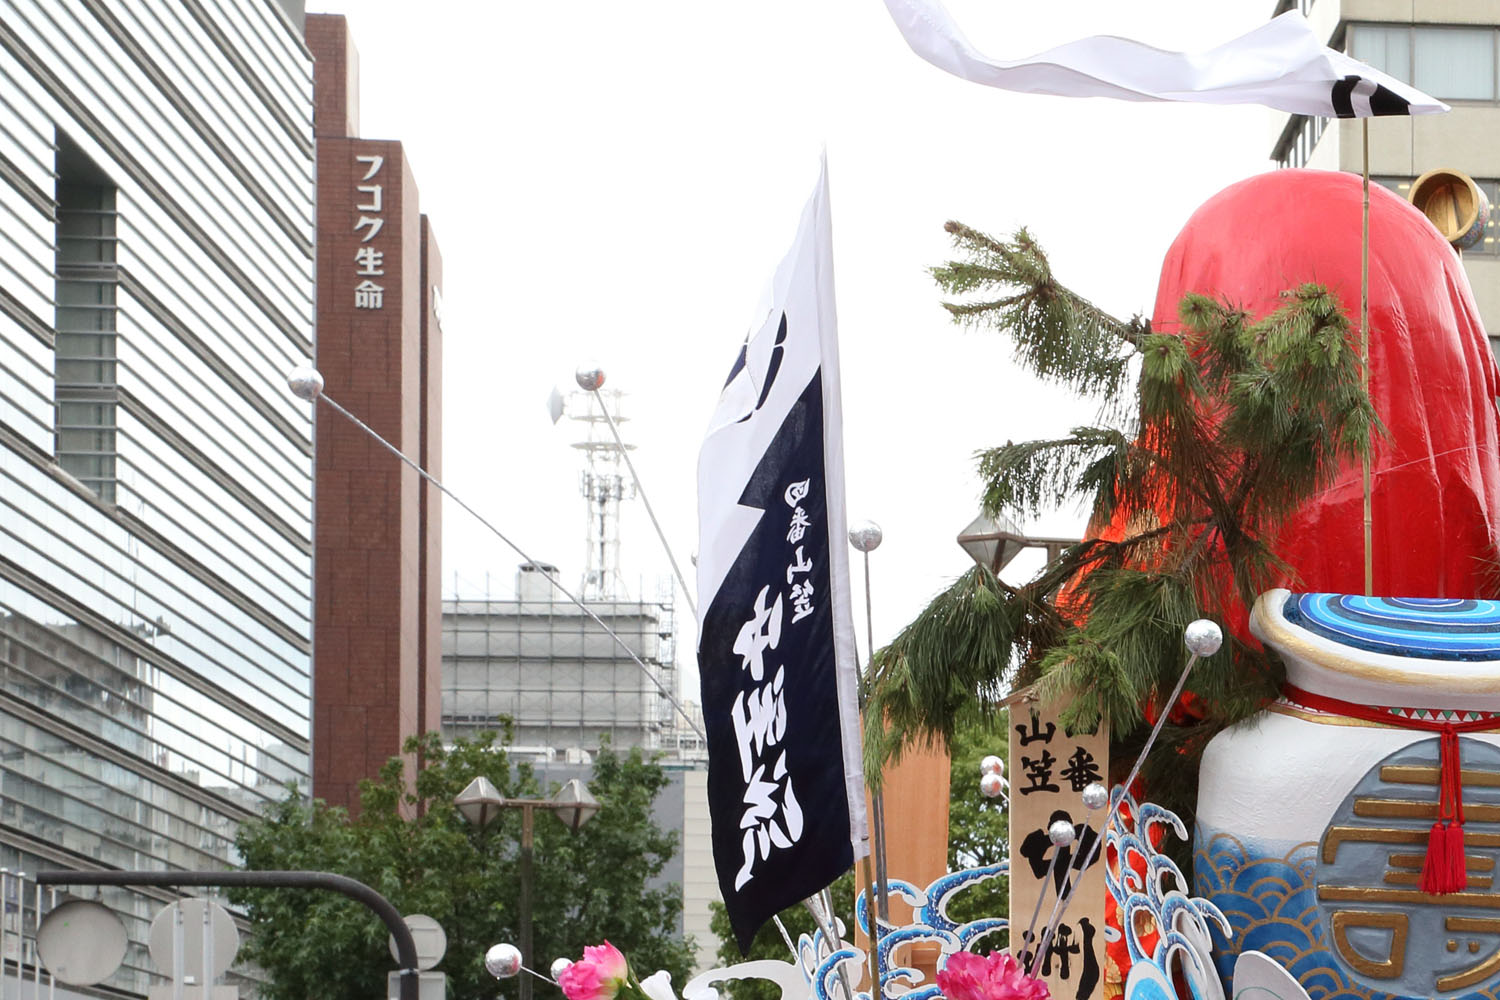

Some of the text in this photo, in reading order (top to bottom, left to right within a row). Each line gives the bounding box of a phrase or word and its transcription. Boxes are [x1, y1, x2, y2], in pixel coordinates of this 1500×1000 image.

[353, 154, 385, 310] フコク生命
[731, 583, 804, 893] 中洲流
[1015, 707, 1060, 796] 山笠
